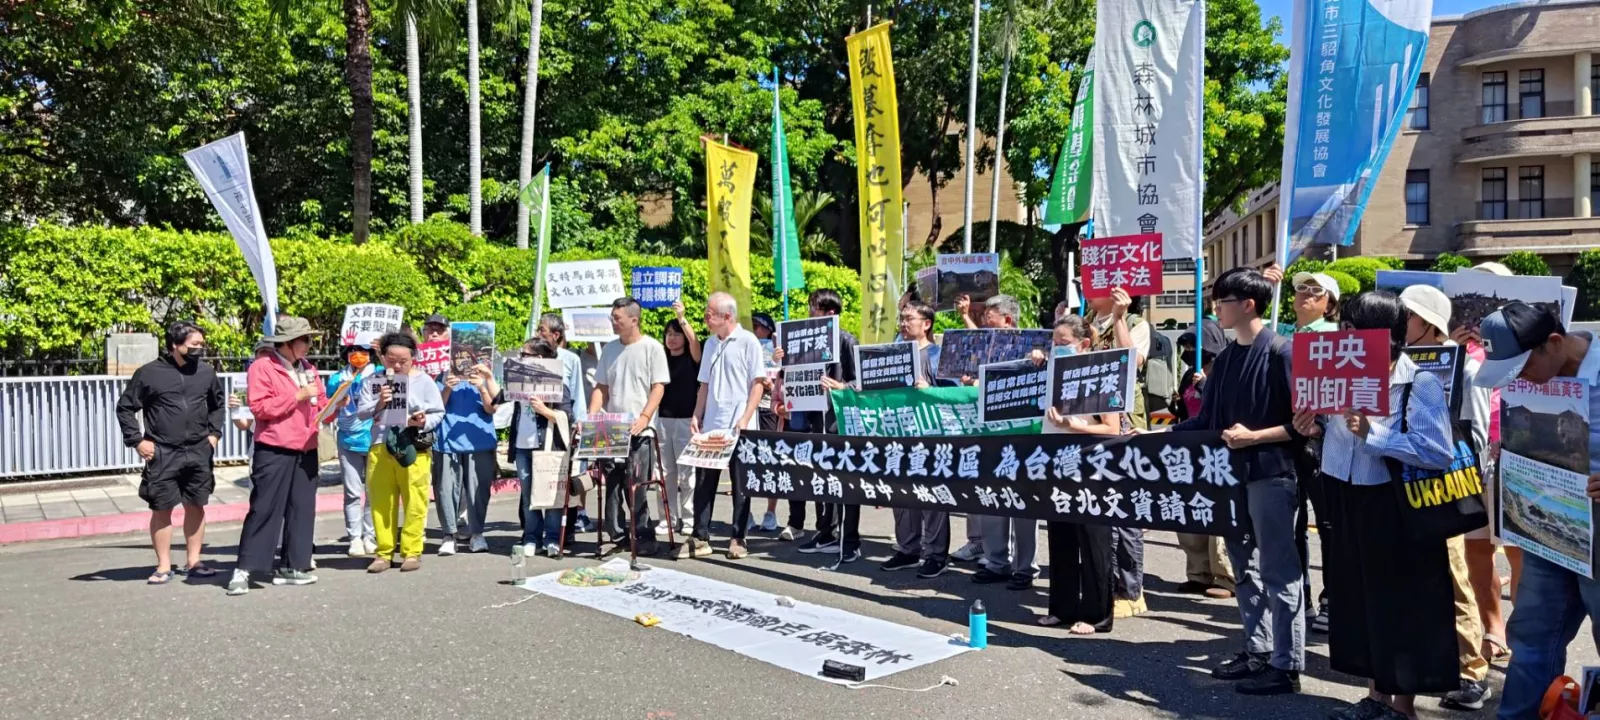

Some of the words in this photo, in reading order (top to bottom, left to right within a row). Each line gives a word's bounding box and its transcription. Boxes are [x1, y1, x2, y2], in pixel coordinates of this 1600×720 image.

[1312, 0, 1340, 179] 市三貂角文化發展協會
[1133, 62, 1159, 234] 森林城市協會
[1081, 243, 1162, 267] 踐行文化
[632, 271, 682, 286] 建立調和
[632, 286, 681, 302] 爭議機制
[1090, 266, 1152, 290] 基本法
[350, 306, 400, 321] 文資審議
[1308, 334, 1366, 371] 中央
[1294, 376, 1383, 415] 別卸責
[737, 439, 981, 479] 搶救全國七大文資重災區
[993, 443, 1239, 487] 為台灣文化留根
[1404, 466, 1483, 510] UKRAINE
